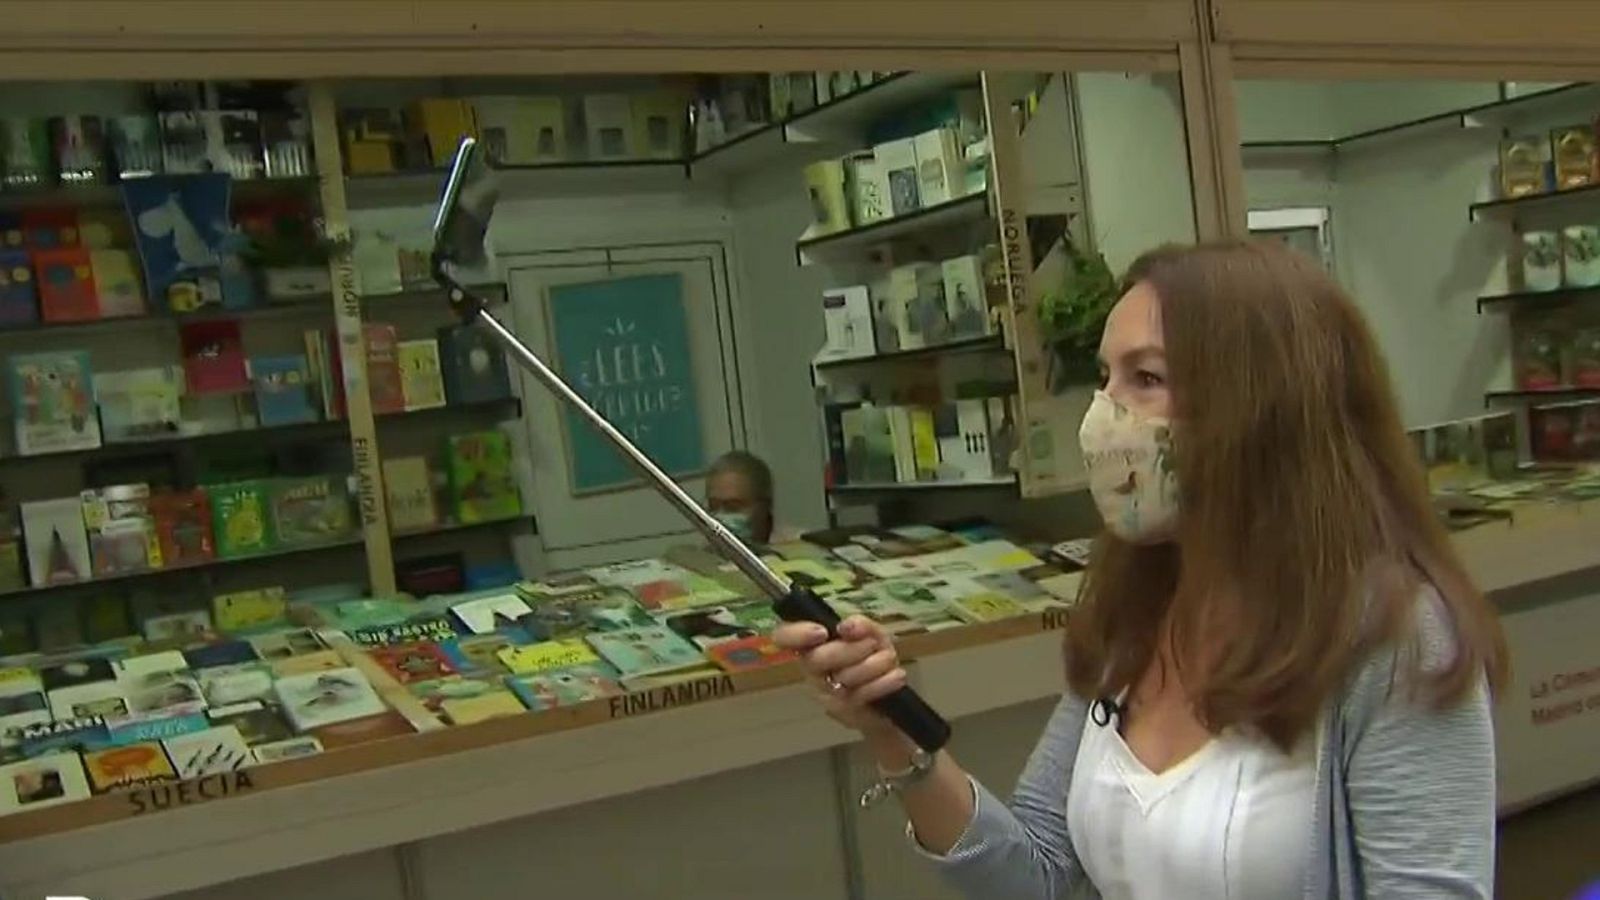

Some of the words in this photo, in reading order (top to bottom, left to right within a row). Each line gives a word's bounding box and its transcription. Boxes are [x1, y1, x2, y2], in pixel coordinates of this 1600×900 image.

[1003, 209, 1029, 317] NORUEGA
[608, 674, 736, 719] FINLANDIA
[128, 771, 255, 816] SUECIA
